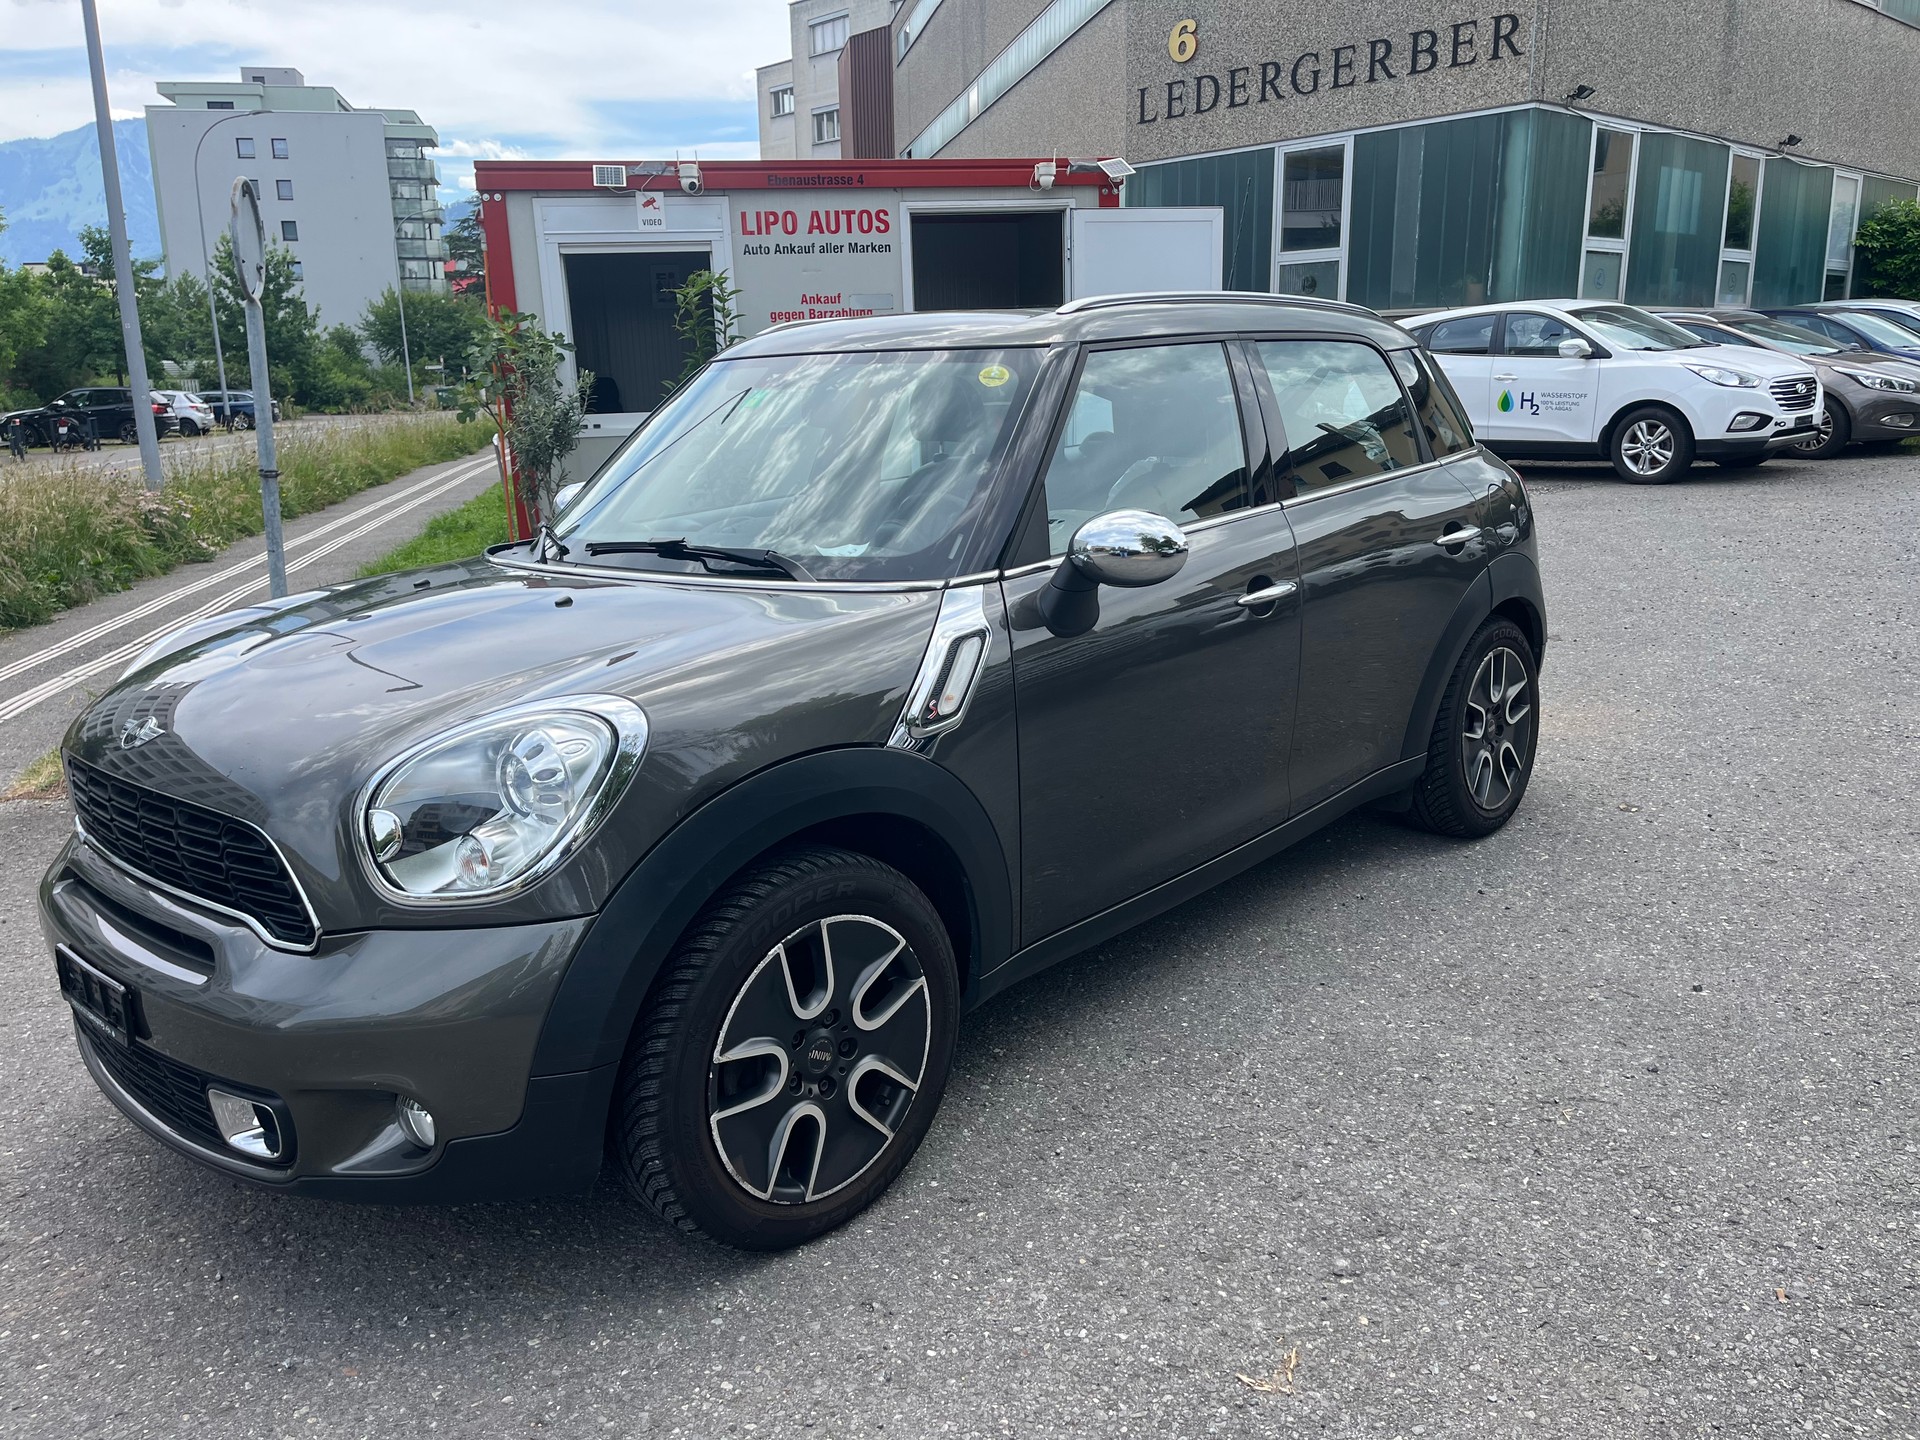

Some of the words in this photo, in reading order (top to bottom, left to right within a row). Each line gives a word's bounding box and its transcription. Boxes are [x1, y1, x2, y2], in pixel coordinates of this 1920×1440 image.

[1168, 18, 1198, 63] 6
[1136, 12, 1525, 125] LEDERGERBER
[767, 174, 854, 187] Ebenaustrasse
[856, 174, 865, 186] 4
[641, 218, 663, 227] VIDEO
[740, 210, 799, 236] LIPO
[807, 209, 891, 235] AUTOS
[743, 243, 771, 256] Auto
[774, 242, 816, 255] Ankauf
[818, 242, 845, 255] aller
[848, 241, 892, 254] Marken
[800, 293, 842, 305] Ankauf
[770, 311, 806, 323] gegen
[1540, 391, 1588, 399] WASSERSTOFF
[731, 880, 858, 969] COOPER
